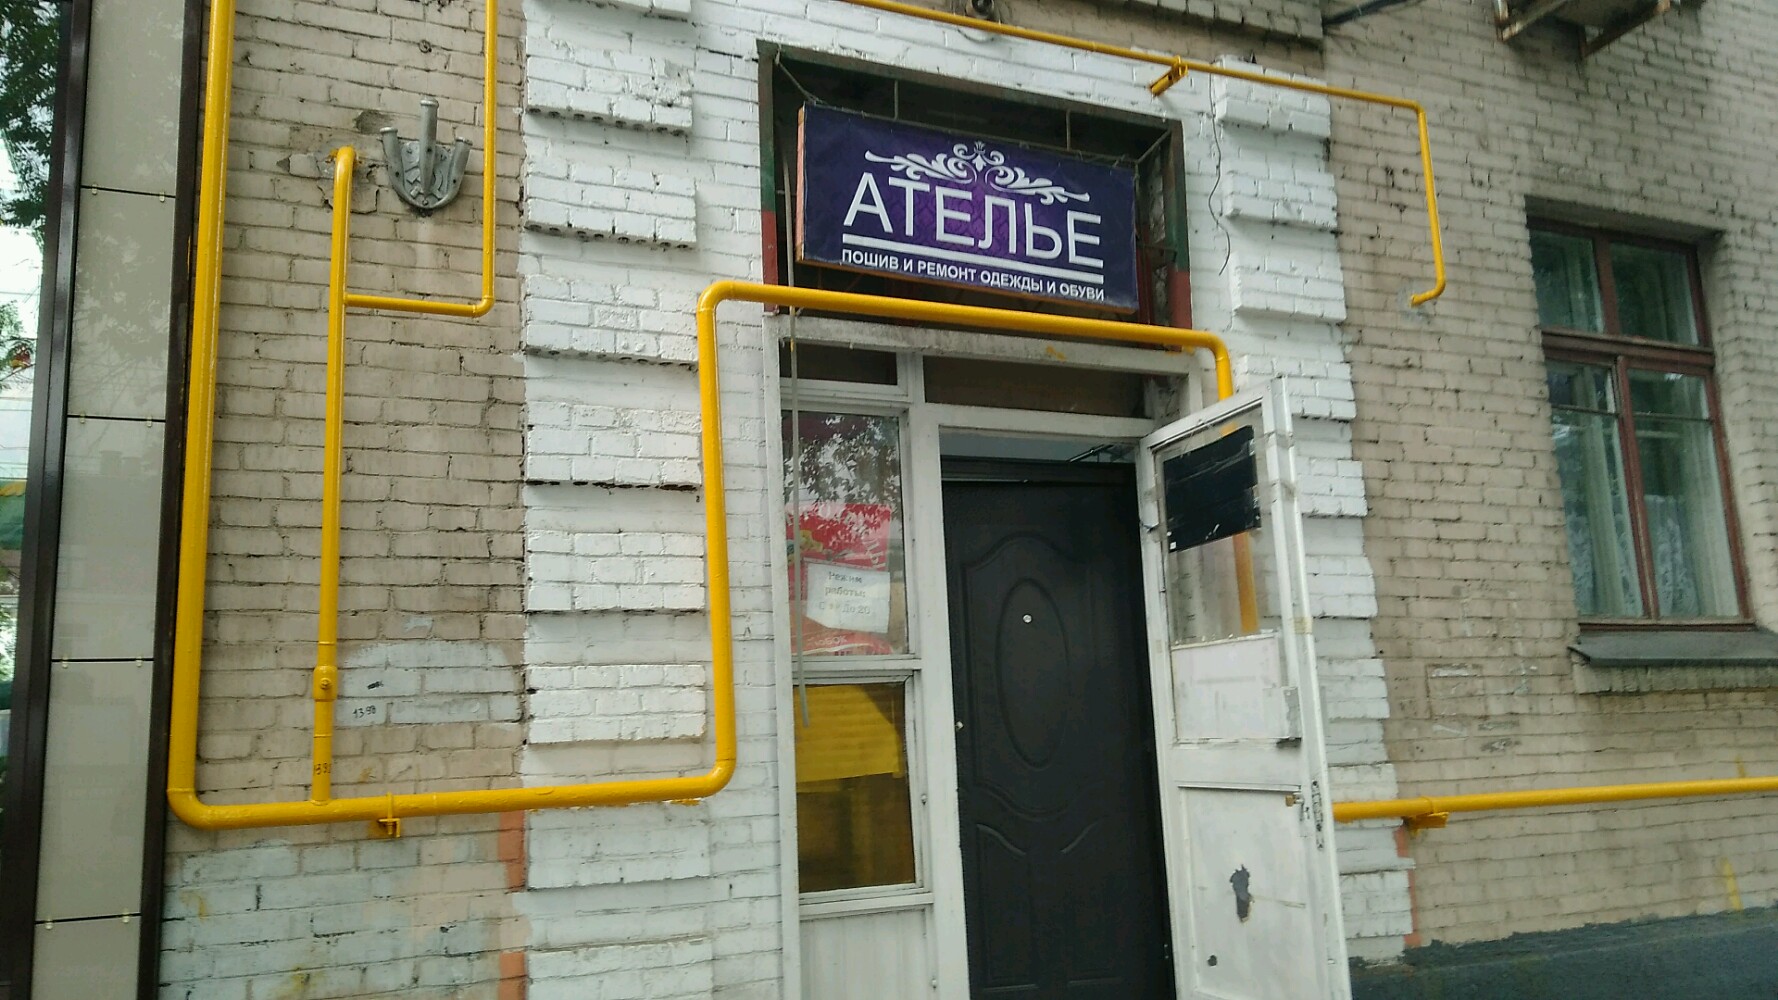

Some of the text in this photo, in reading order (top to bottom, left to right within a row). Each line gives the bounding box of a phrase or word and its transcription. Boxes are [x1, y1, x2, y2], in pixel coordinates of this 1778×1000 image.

[843, 172, 1104, 269] АТЕЛЬЕ
[842, 249, 1105, 301] ПОШИВ И РЕМОНТ ОДЕЖДЫ И ОБУВИ
